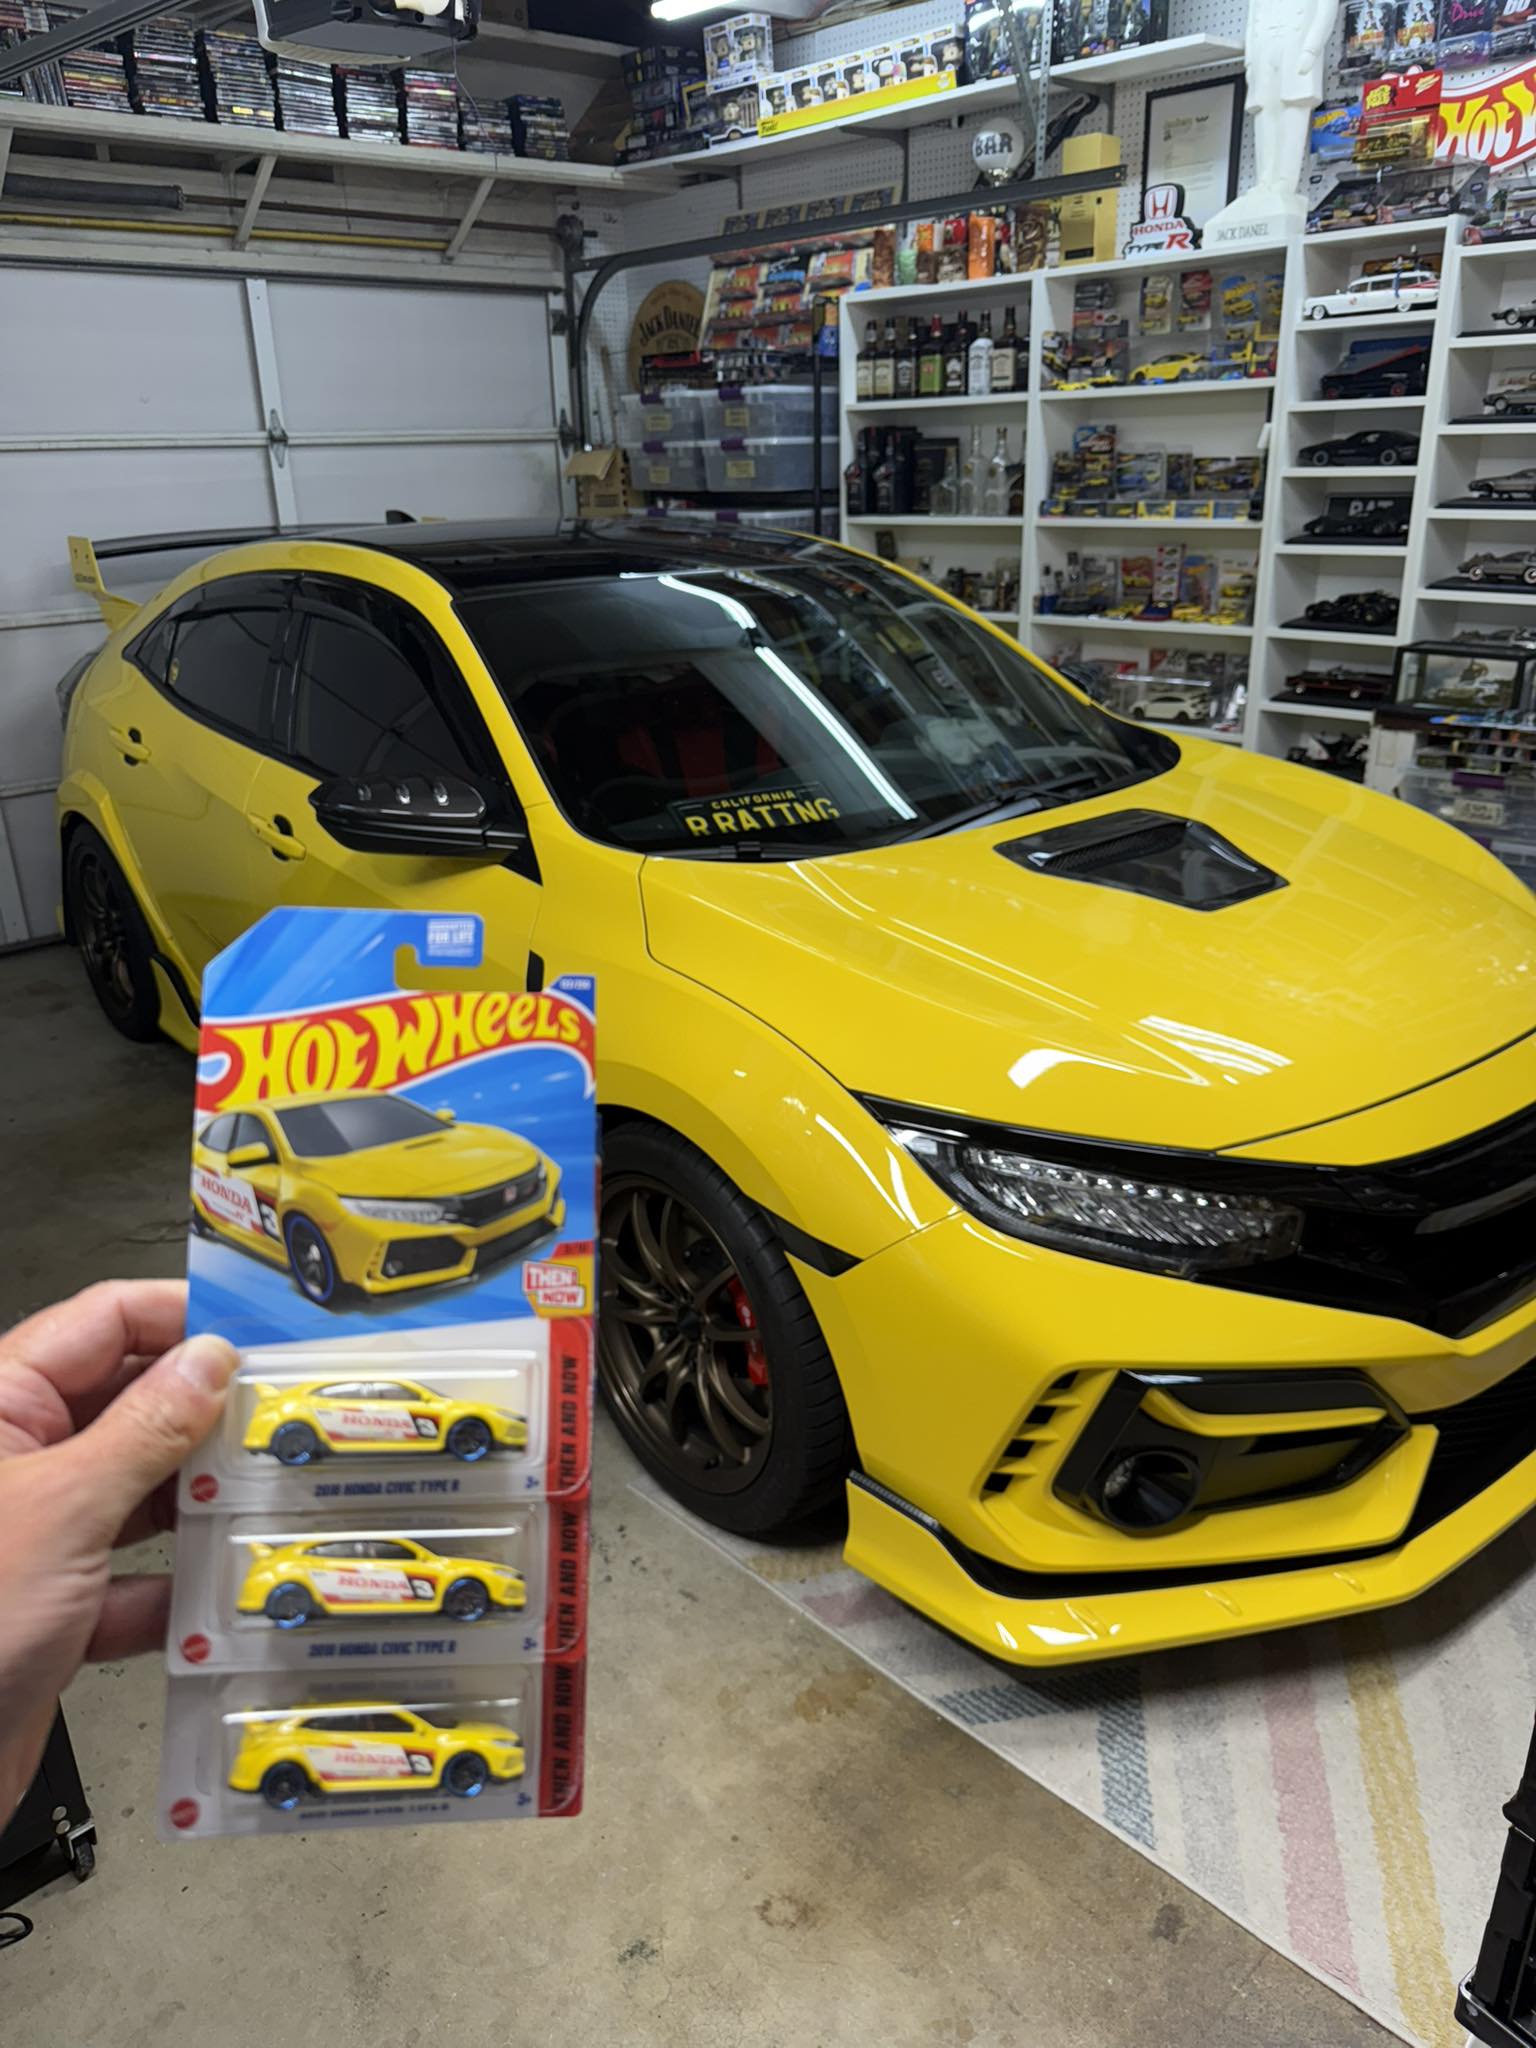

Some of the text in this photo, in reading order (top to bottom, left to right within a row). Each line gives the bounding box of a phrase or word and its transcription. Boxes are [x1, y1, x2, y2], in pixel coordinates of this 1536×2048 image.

[975, 133, 1013, 157] BAR
[1133, 221, 1185, 236] HONDA
[1216, 223, 1269, 242] JACK DANIEL
[1166, 232, 1190, 250] R
[711, 789, 797, 811] CALIFORNIA
[199, 1175, 254, 1217] HONDA
[561, 1355, 577, 1395] NOW
[342, 1414, 412, 1429] HONDA
[560, 1401, 577, 1436] AND
[343, 1481, 382, 1496] HONDA
[385, 1480, 416, 1494] CIVIC
[420, 1479, 448, 1493] TYPE
[561, 1511, 578, 1553] NOW
[338, 1575, 409, 1591] HONDA
[560, 1559, 577, 1597] AND
[338, 1642, 378, 1657] HONDA
[381, 1641, 412, 1655] CIVIC
[415, 1640, 446, 1654] TYPE
[555, 1665, 573, 1707] NOW
[554, 1713, 571, 1751] AND
[334, 1752, 406, 1766] HONDA
